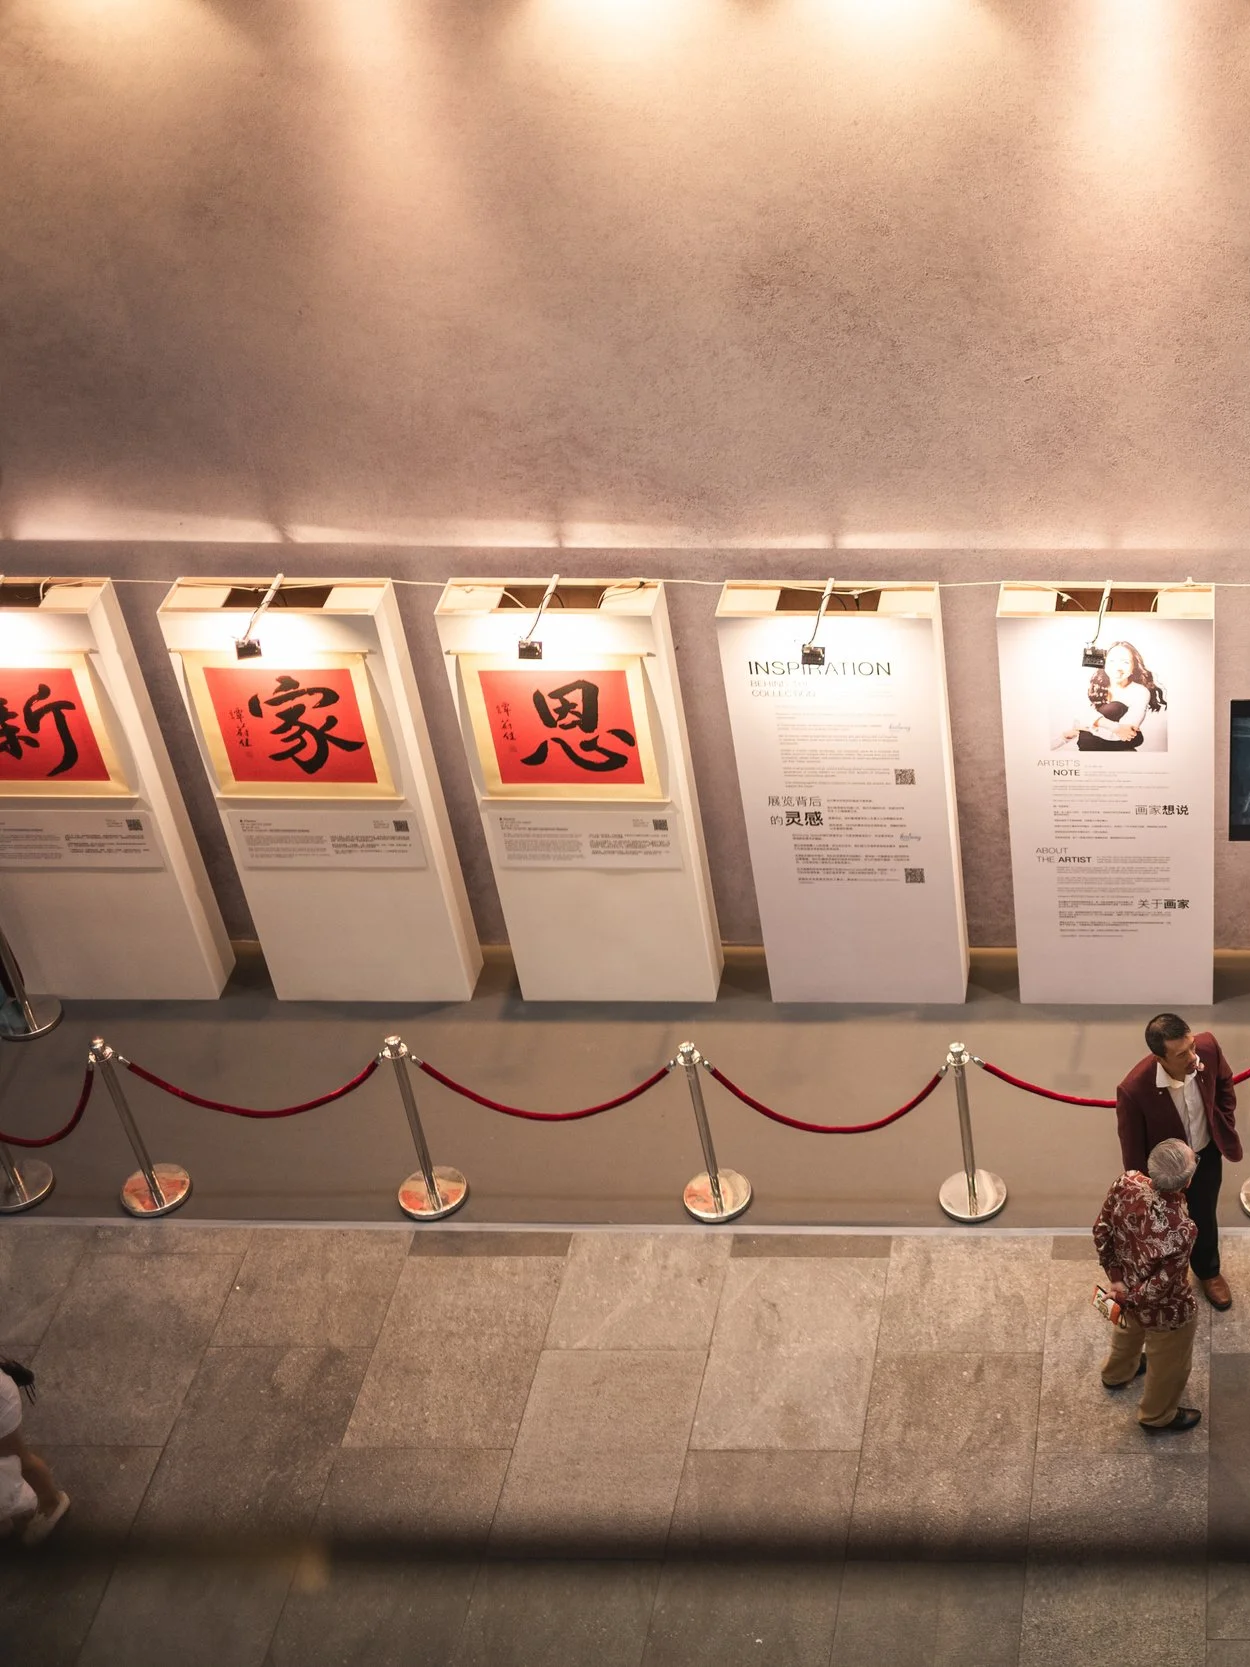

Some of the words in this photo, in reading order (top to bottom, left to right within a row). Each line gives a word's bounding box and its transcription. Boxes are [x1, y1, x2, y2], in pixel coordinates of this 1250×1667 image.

[748, 660, 891, 676] INSPIRATION
[247, 675, 365, 775] 家
[519, 679, 636, 772] 恩
[1037, 759, 1081, 767] ARTIST'S
[767, 795, 822, 807] 展览背后
[1135, 805, 1189, 815] 画家想说
[770, 811, 824, 827] 的灵感
[1138, 899, 1190, 909] 关于画家
